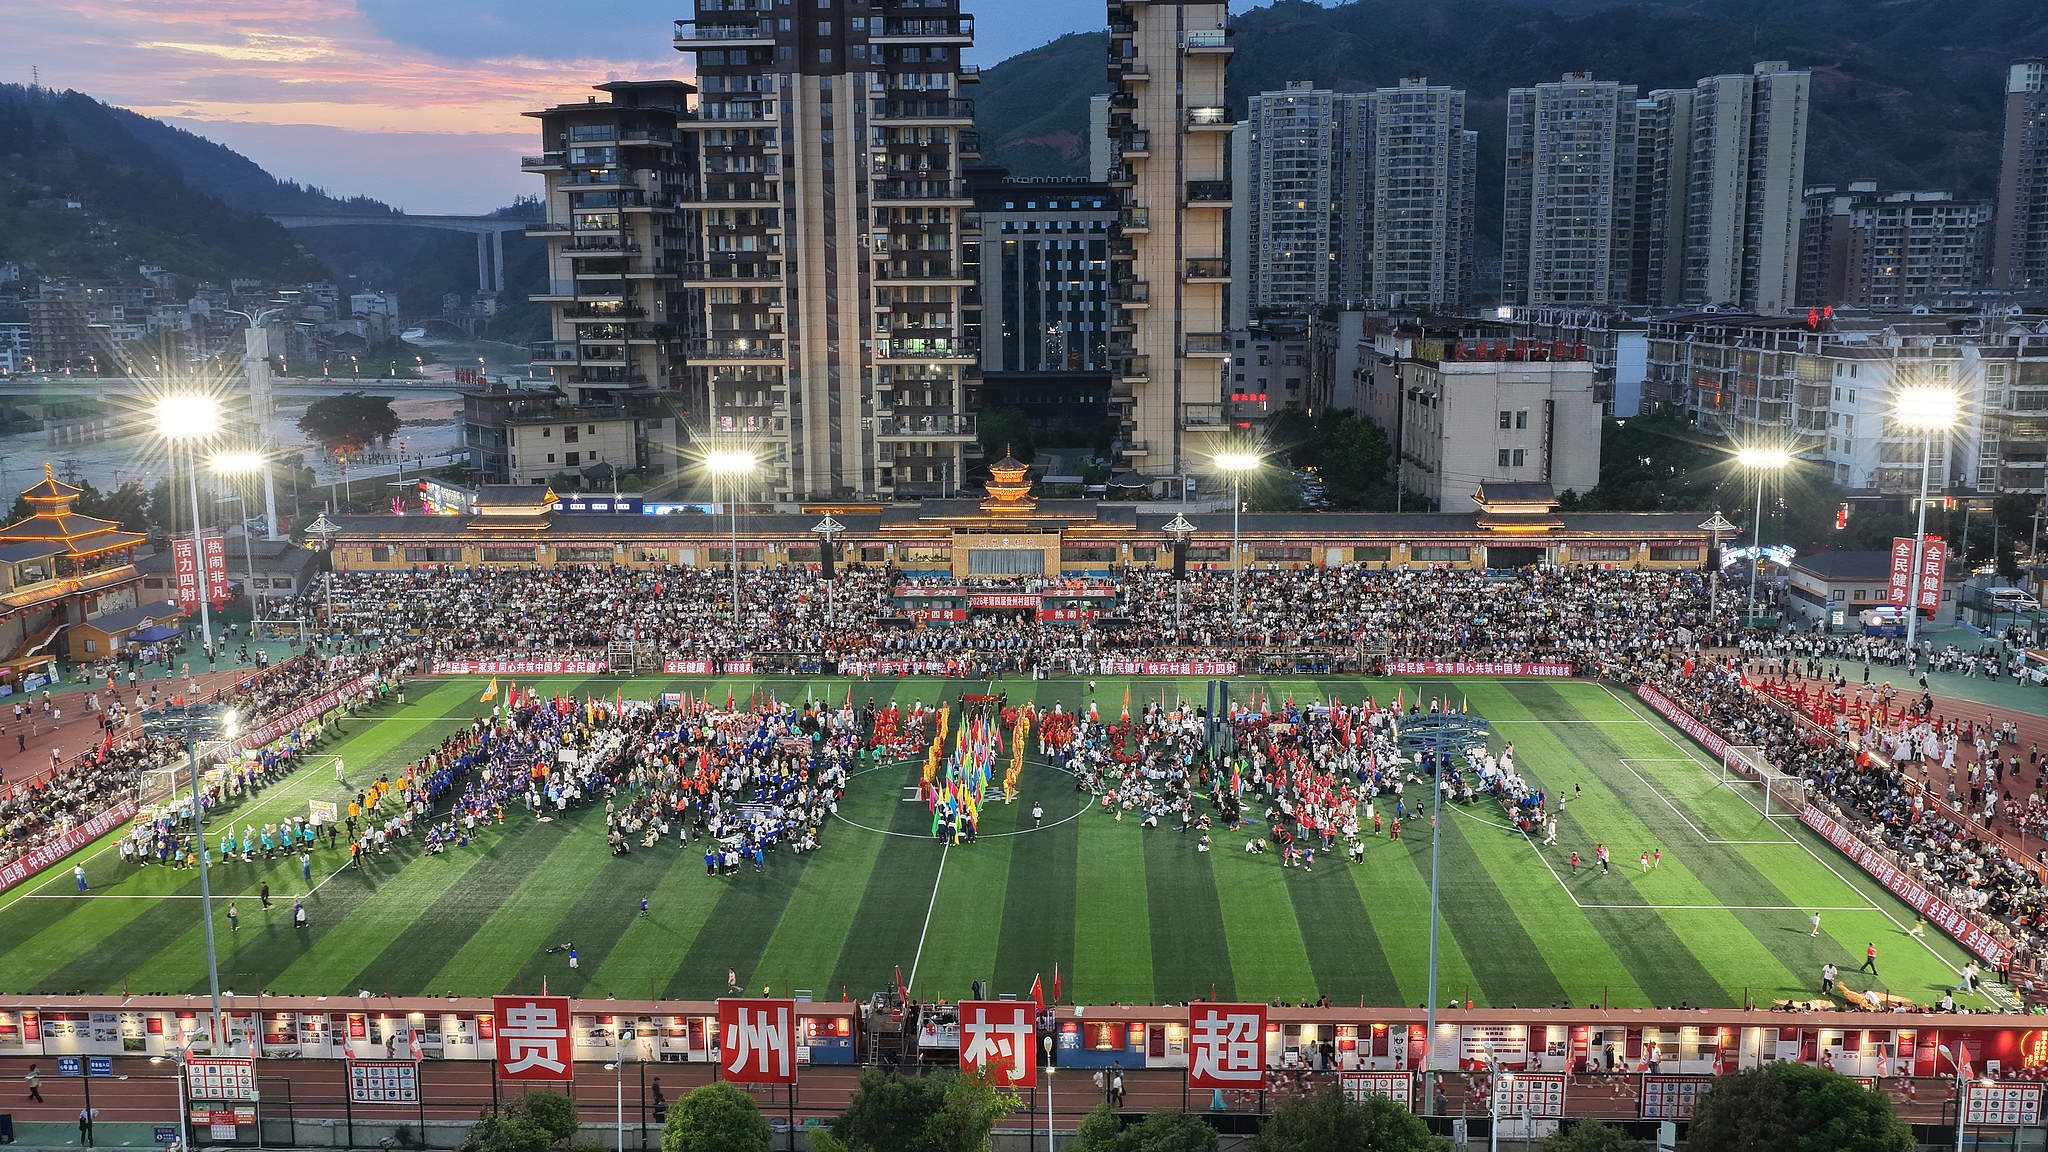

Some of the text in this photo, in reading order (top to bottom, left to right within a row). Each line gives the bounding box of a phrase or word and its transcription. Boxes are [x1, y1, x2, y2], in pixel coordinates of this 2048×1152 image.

[177, 543, 196, 601] 活力四射
[208, 541, 226, 598] 热闹非凡
[1891, 543, 1910, 602] 全民健身
[1922, 546, 1941, 606] 全民健康
[498, 661, 562, 672] 同心共筑中国梦
[667, 662, 706, 673] 全民健康
[1149, 663, 1190, 675] 快乐村超
[1195, 663, 1236, 675] 活力四射
[1388, 662, 1454, 674] 中华民族一家亲
[1457, 662, 1522, 674] 同心共筑中国梦
[28, 829, 85, 870] 中央帮扶暖人心
[1860, 851, 1895, 886] 快乐村超
[1891, 874, 1929, 910] 活力四射
[1927, 900, 1967, 938] 全民健身
[500, 1003, 1262, 1081] 贵 州 村 超
